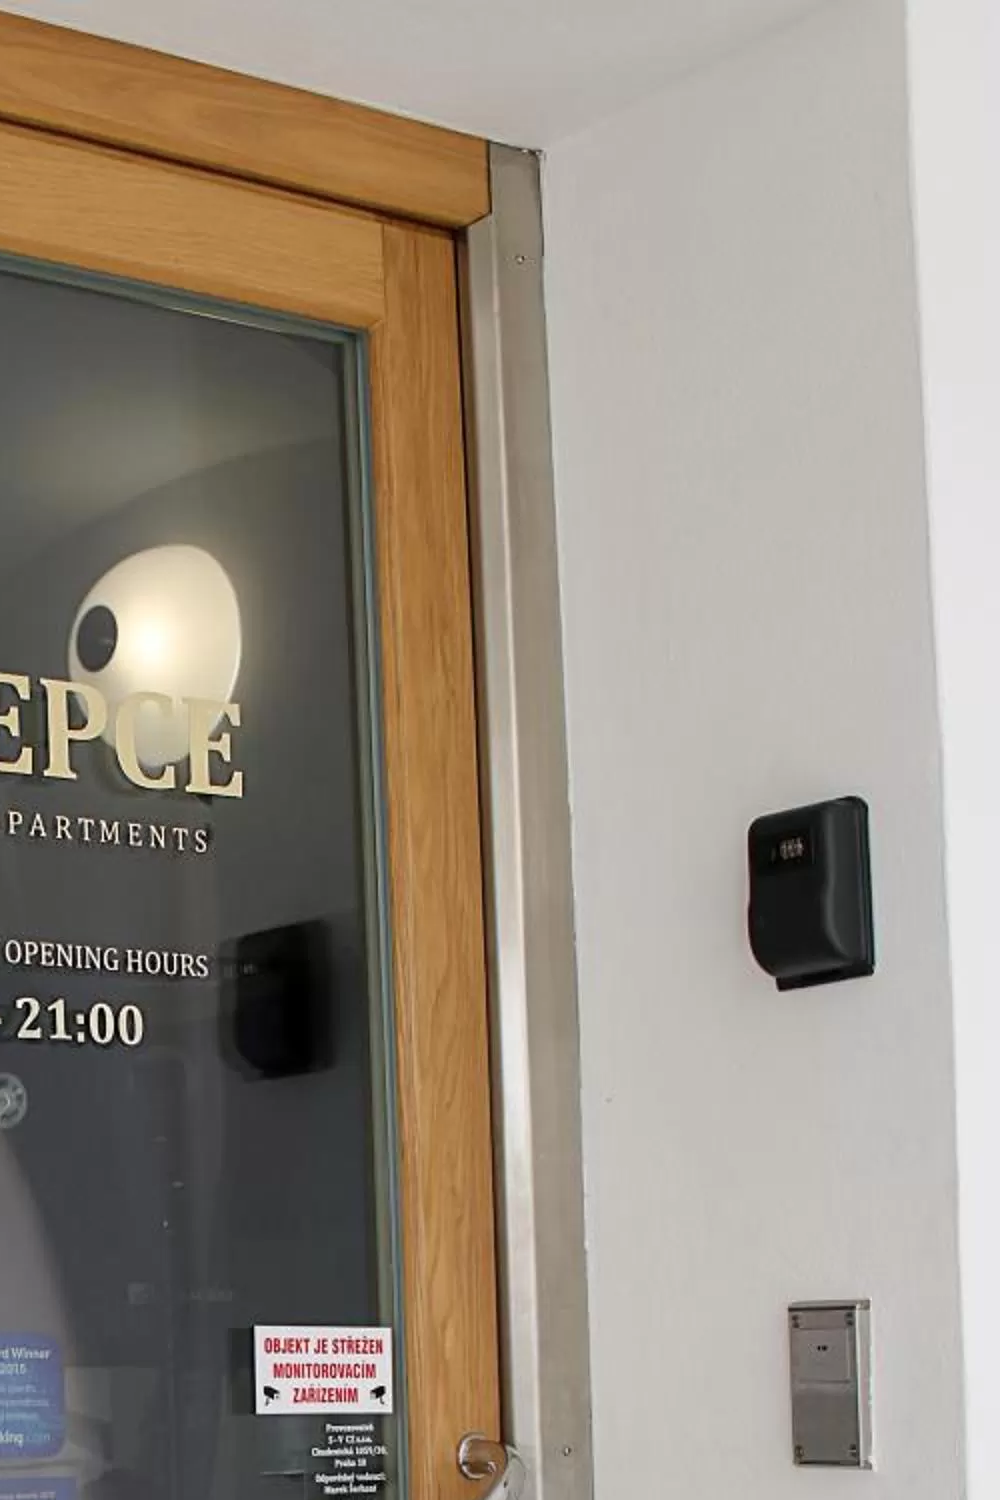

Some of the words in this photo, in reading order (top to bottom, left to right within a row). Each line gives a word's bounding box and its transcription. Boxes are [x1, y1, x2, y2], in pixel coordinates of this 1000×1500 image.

[5, 940, 120, 972] OPENING
[126, 951, 209, 978] HOURS
[16, 997, 144, 1045] 21:00
[11, 1347, 50, 1359] Winner
[264, 1337, 310, 1354] OBJEKT
[314, 1338, 329, 1354] JE
[332, 1335, 383, 1354] STŘEŽEN
[273, 1360, 376, 1378] MONITOROVACÍM
[293, 1383, 358, 1403] ZAŘÍZENÍM
